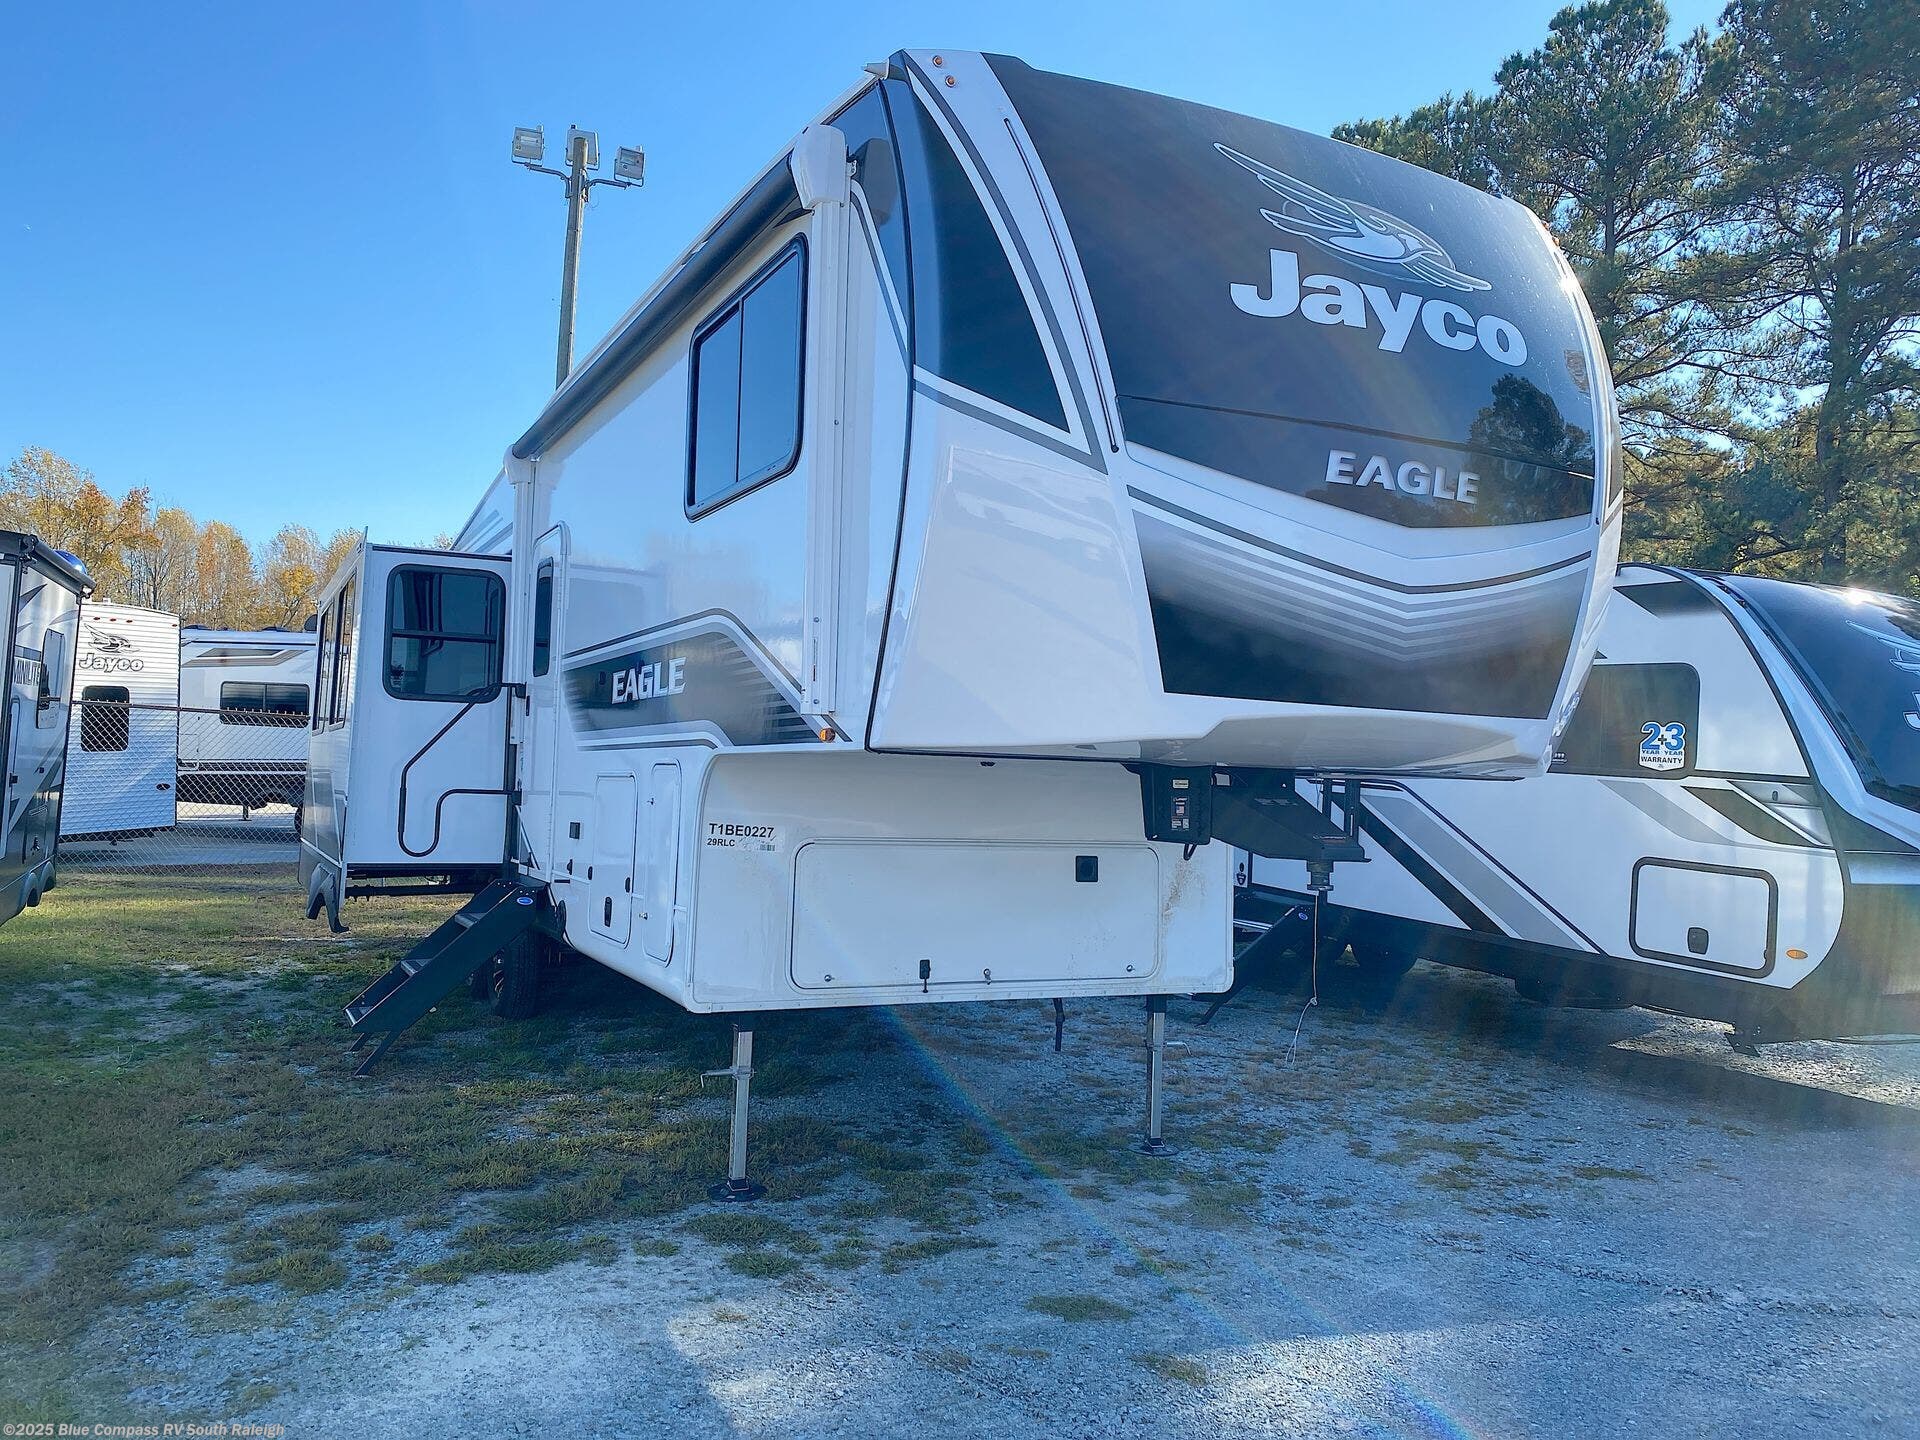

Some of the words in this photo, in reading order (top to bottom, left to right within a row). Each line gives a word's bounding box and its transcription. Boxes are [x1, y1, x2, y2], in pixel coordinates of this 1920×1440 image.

[1230, 248, 1528, 368] Jayco
[1325, 449, 1481, 505] EAGLE
[79, 652, 144, 673] Jayco
[611, 656, 688, 705] EAGLE
[1640, 756, 1683, 764] WARRANTY
[708, 822, 775, 838] T1BE0227
[706, 837, 736, 847] 29RLC
